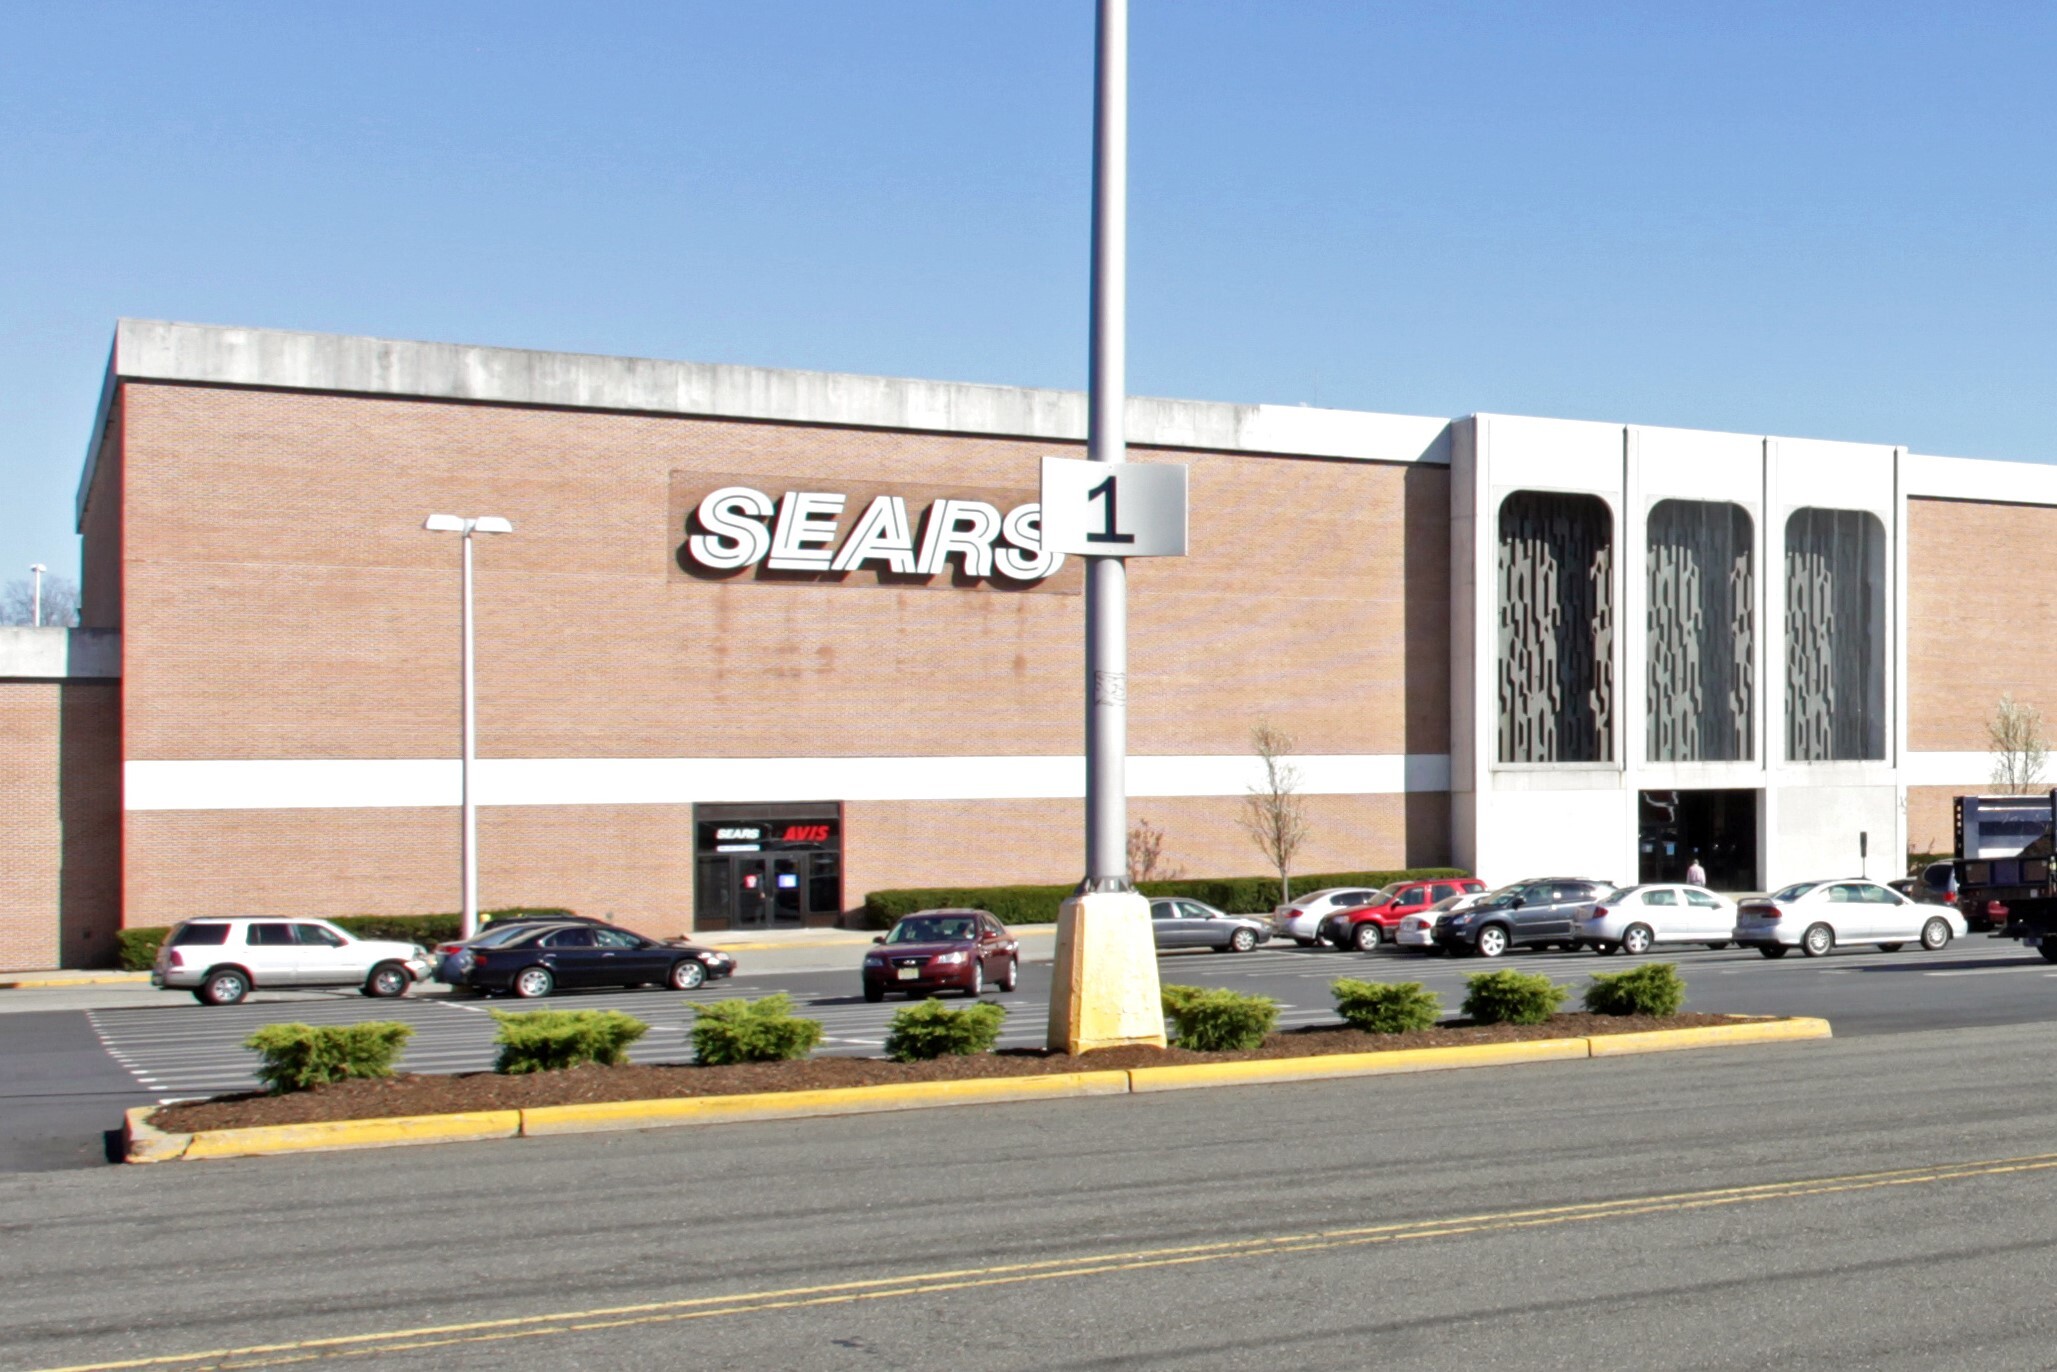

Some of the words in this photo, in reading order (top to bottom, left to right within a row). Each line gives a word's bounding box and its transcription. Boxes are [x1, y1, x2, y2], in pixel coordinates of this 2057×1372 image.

[1086, 475, 1135, 544] 1
[688, 486, 1066, 580] SEARS
[716, 828, 760, 840] SEARS
[783, 825, 829, 842] AVIS
